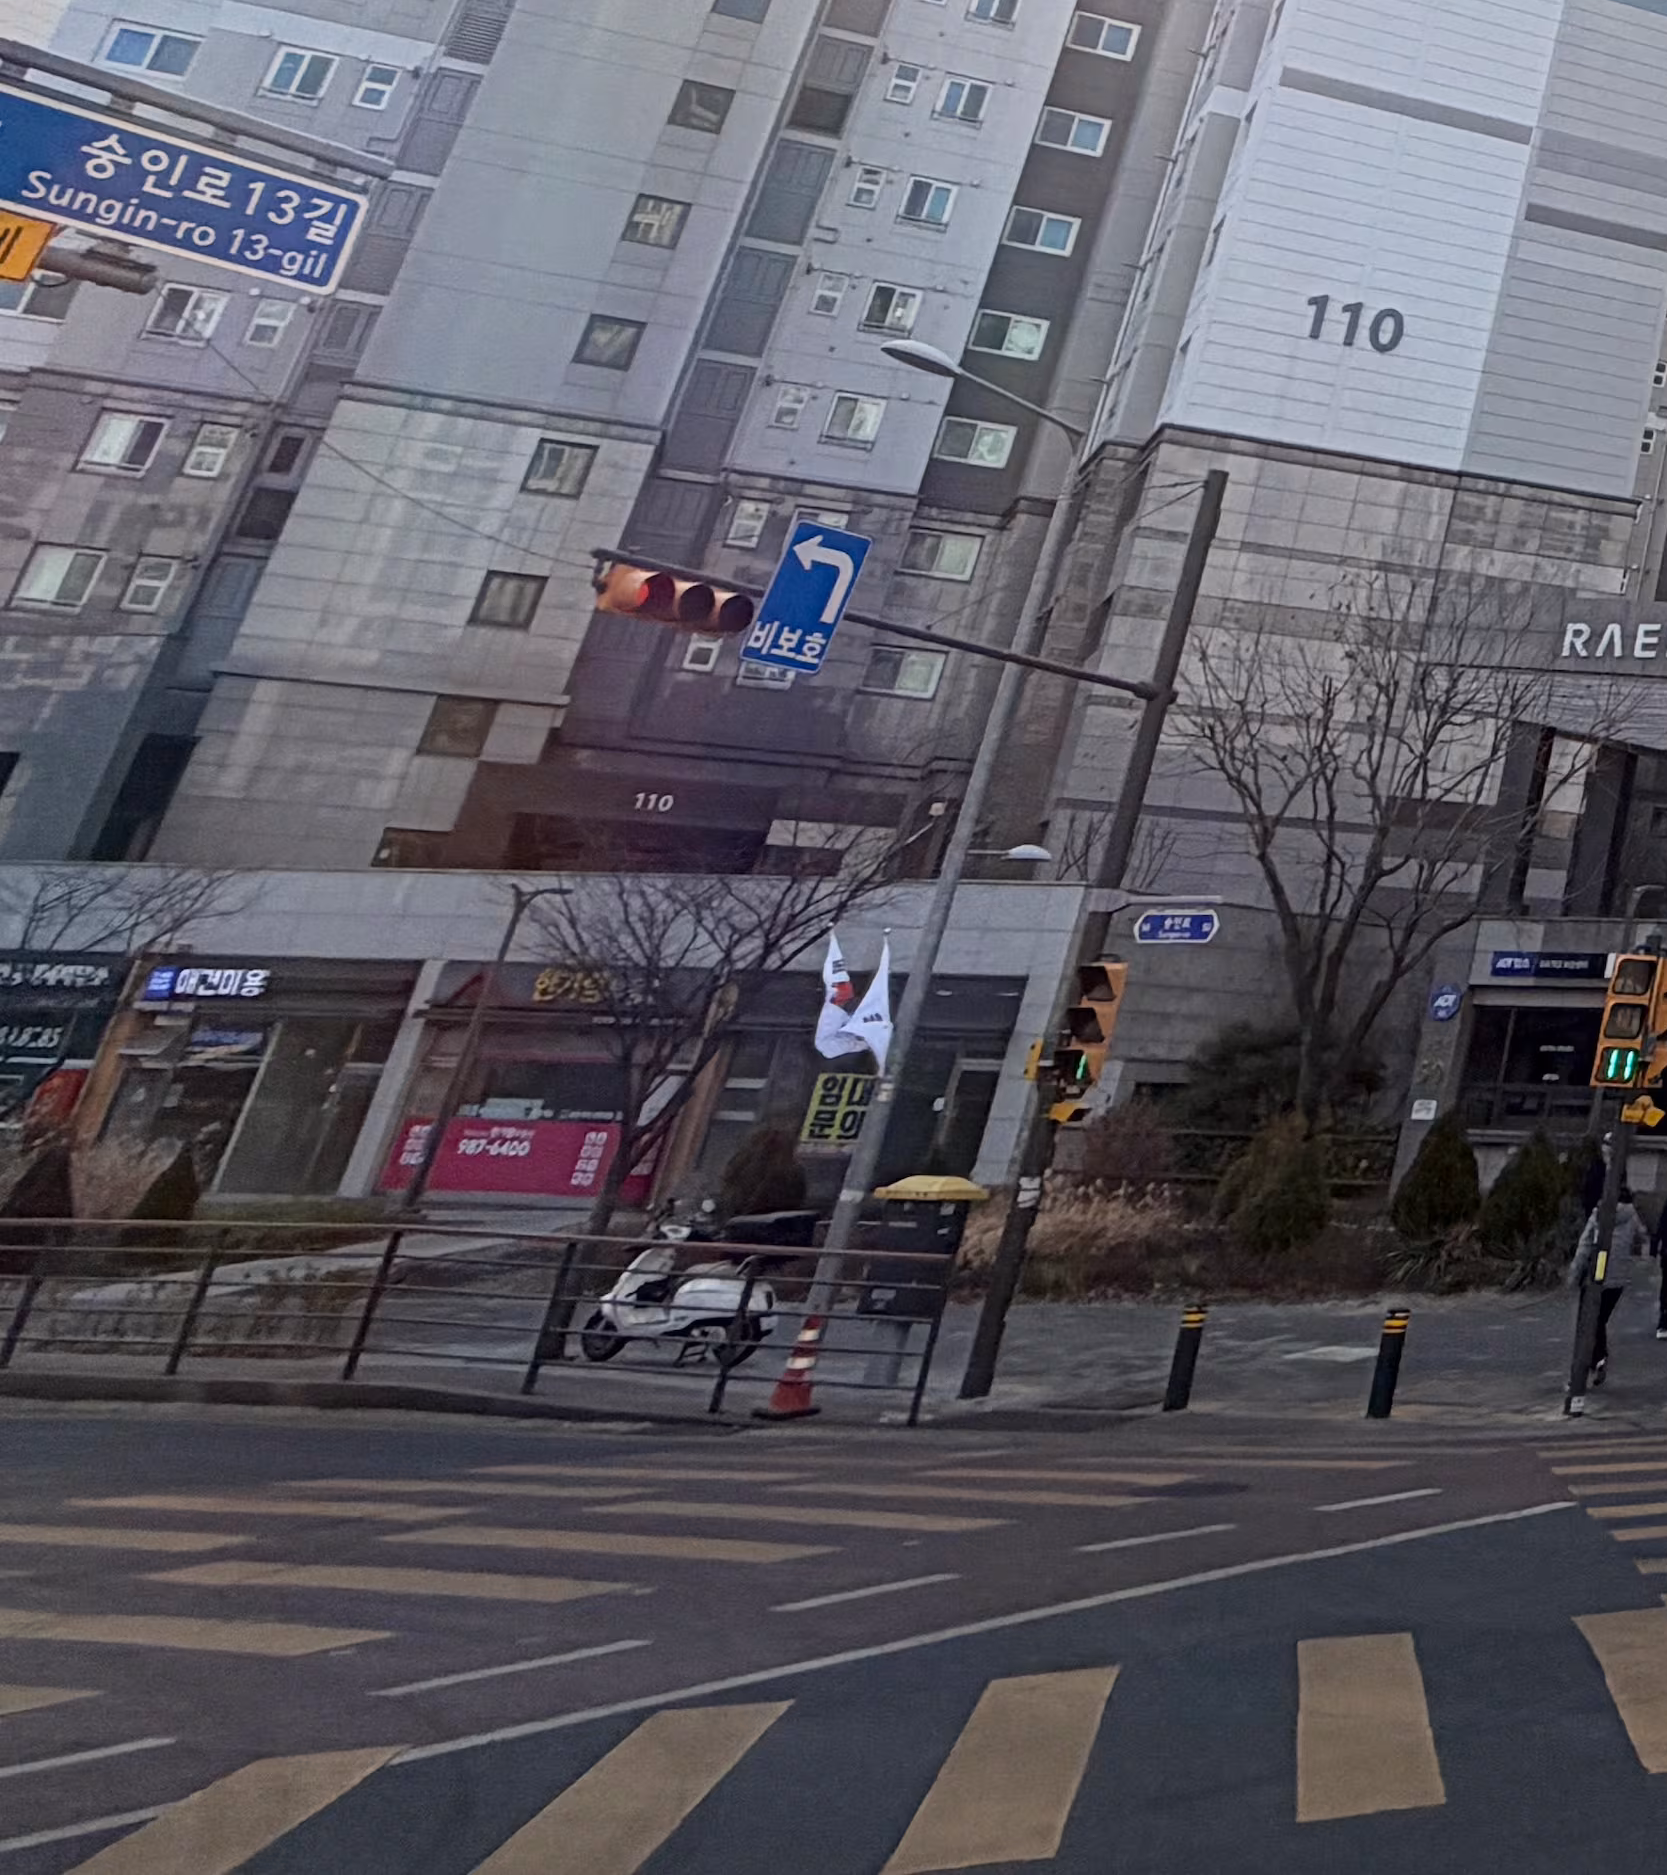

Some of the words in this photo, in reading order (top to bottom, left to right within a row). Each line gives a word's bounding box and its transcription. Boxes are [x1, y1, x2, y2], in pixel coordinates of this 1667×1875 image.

[79, 133, 348, 246] 숭인로13길
[20, 169, 217, 247] Sungin-ro
[229, 227, 329, 279] 13-gil
[1306, 293, 1405, 354] 110
[746, 620, 827, 664] 비보호
[634, 792, 674, 812] 110
[808, 1110, 867, 1140] 문의
